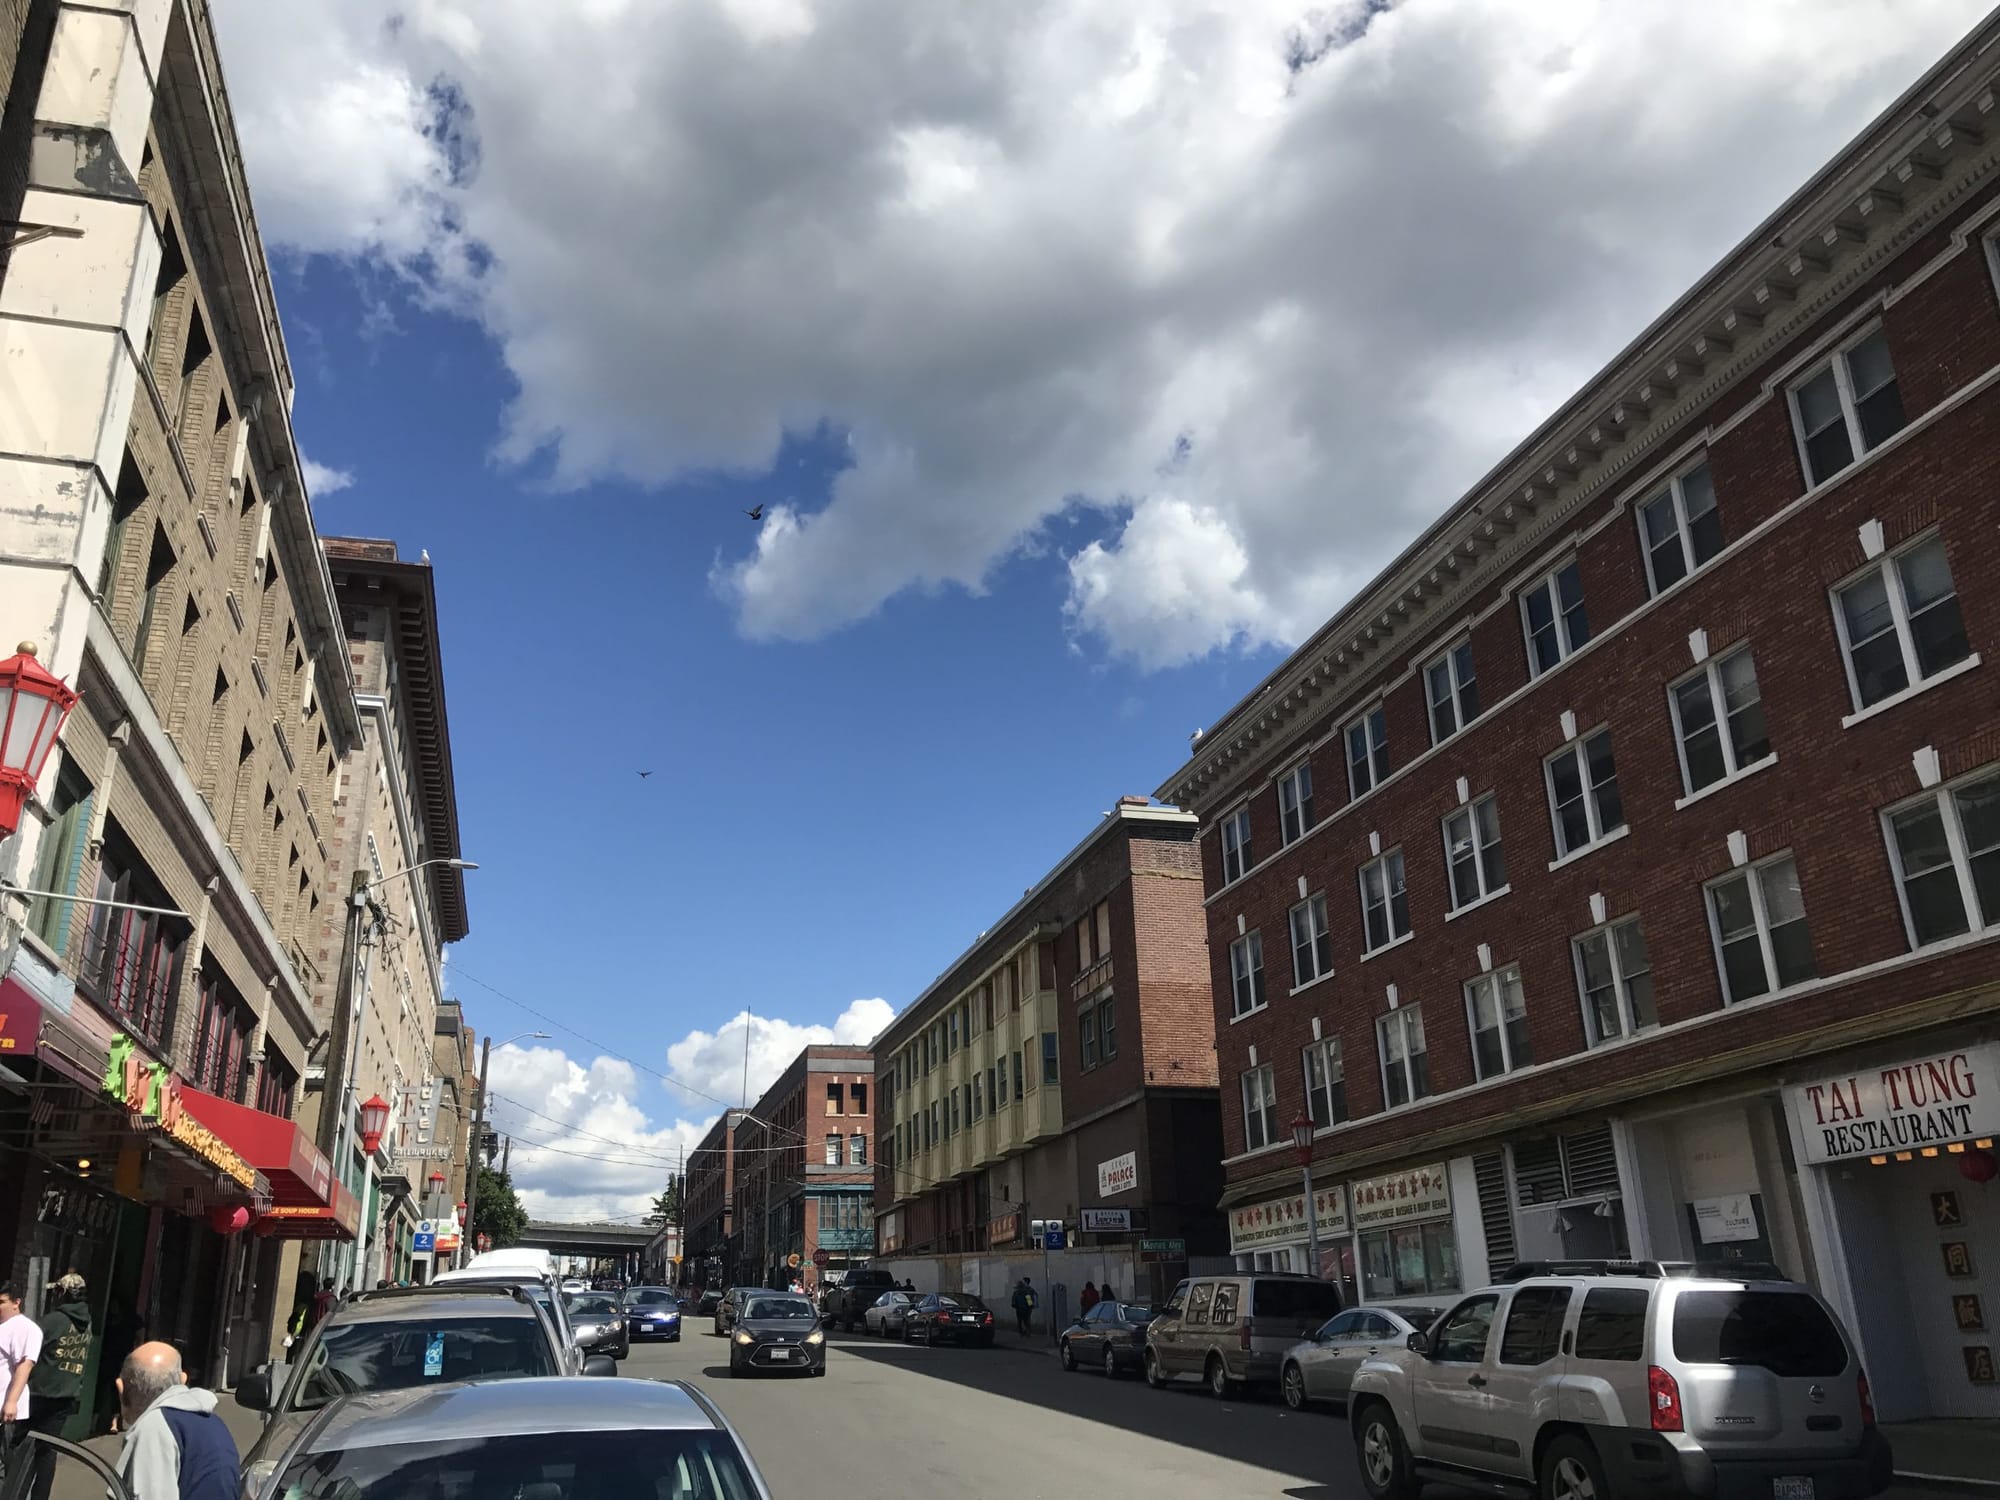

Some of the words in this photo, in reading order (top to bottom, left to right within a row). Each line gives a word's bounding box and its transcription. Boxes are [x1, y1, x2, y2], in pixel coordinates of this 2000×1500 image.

[1805, 1077, 1865, 1126] TAI
[1881, 1054, 1977, 1112] TUNG
[417, 1073, 434, 1143] HOTEL
[1822, 1103, 1974, 1157] RESTAURANT
[1108, 1165, 1134, 1186] PALACE
[420, 1235, 428, 1244] 2
[1051, 1233, 1059, 1243] 2
[814, 1253, 829, 1261] STOP
